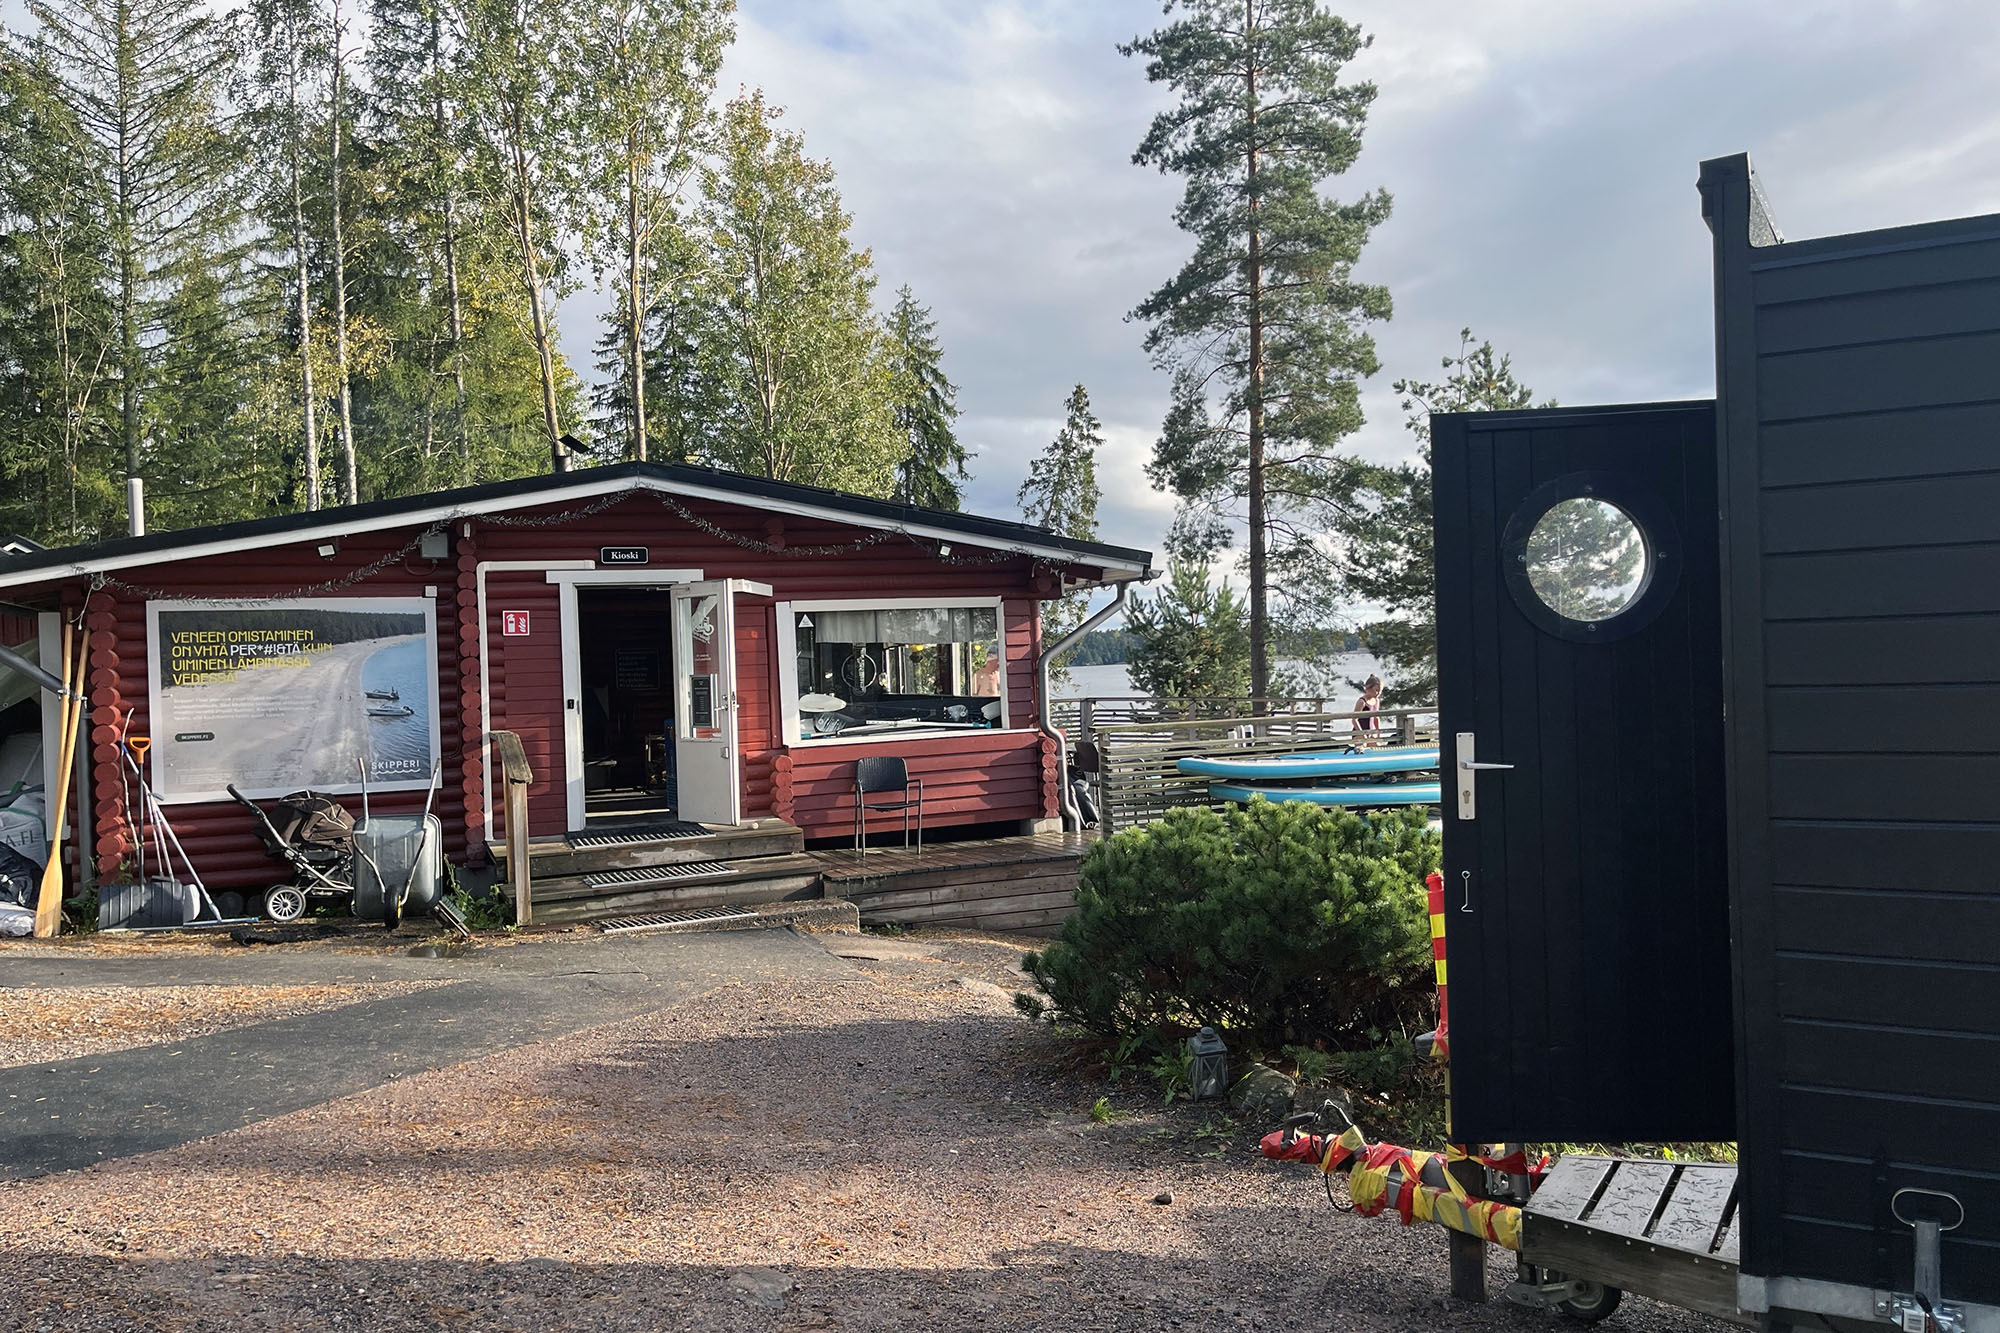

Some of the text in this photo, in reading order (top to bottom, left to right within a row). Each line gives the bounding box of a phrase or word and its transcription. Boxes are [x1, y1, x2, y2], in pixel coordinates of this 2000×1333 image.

[611, 551, 639, 560] Kioski
[171, 630, 313, 644] VENEEN OMISTAMINEN
[172, 645, 192, 658] ON
[194, 643, 229, 657] YHTÄ
[302, 643, 333, 655] KUIN
[172, 655, 311, 671] UIMINEN LÄMPIMÄSSÄ
[371, 760, 420, 770] SKIPPERI
